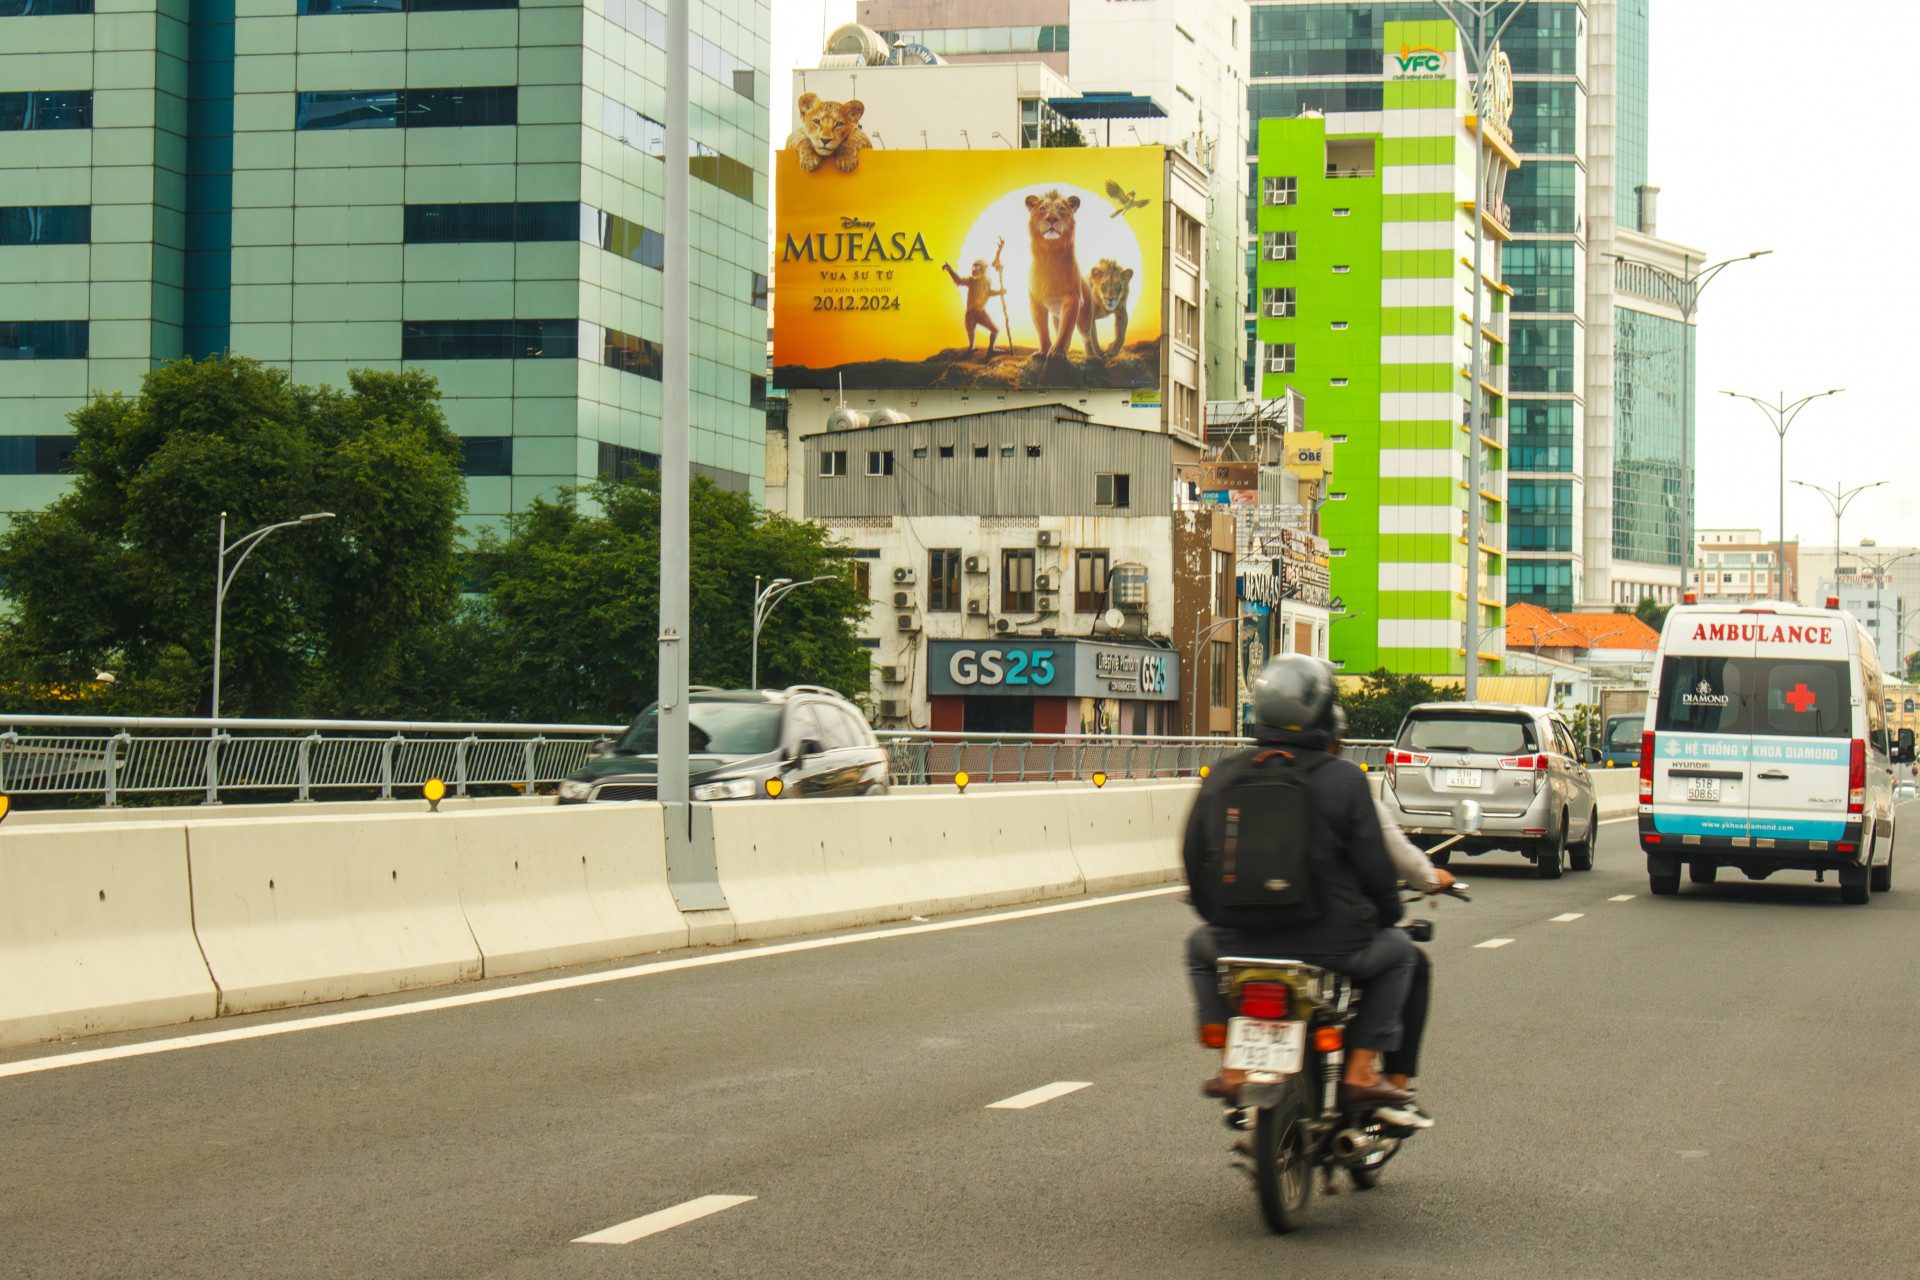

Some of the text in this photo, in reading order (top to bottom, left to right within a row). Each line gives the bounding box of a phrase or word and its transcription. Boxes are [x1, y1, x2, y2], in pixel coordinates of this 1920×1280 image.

[1394, 55, 1440, 71] VFC
[840, 216, 875, 232] Disney
[781, 232, 933, 262] MUFASA
[820, 271, 846, 280] VUA
[854, 270, 869, 280] SƯ
[813, 296, 900, 311] 20.12.2024
[1693, 622, 1831, 645] AMBULANCE
[949, 649, 1055, 685] GS25
[1142, 655, 1167, 692] GS25
[1682, 694, 1729, 703] DIAMOND
[1685, 740, 1838, 760] HỆ THỐNG Y KHOA DIAMOND
[1695, 778, 1713, 788] 51B
[1688, 788, 1719, 800] 508.65
[1701, 821, 1794, 832] www.ykhoadiamond.com
